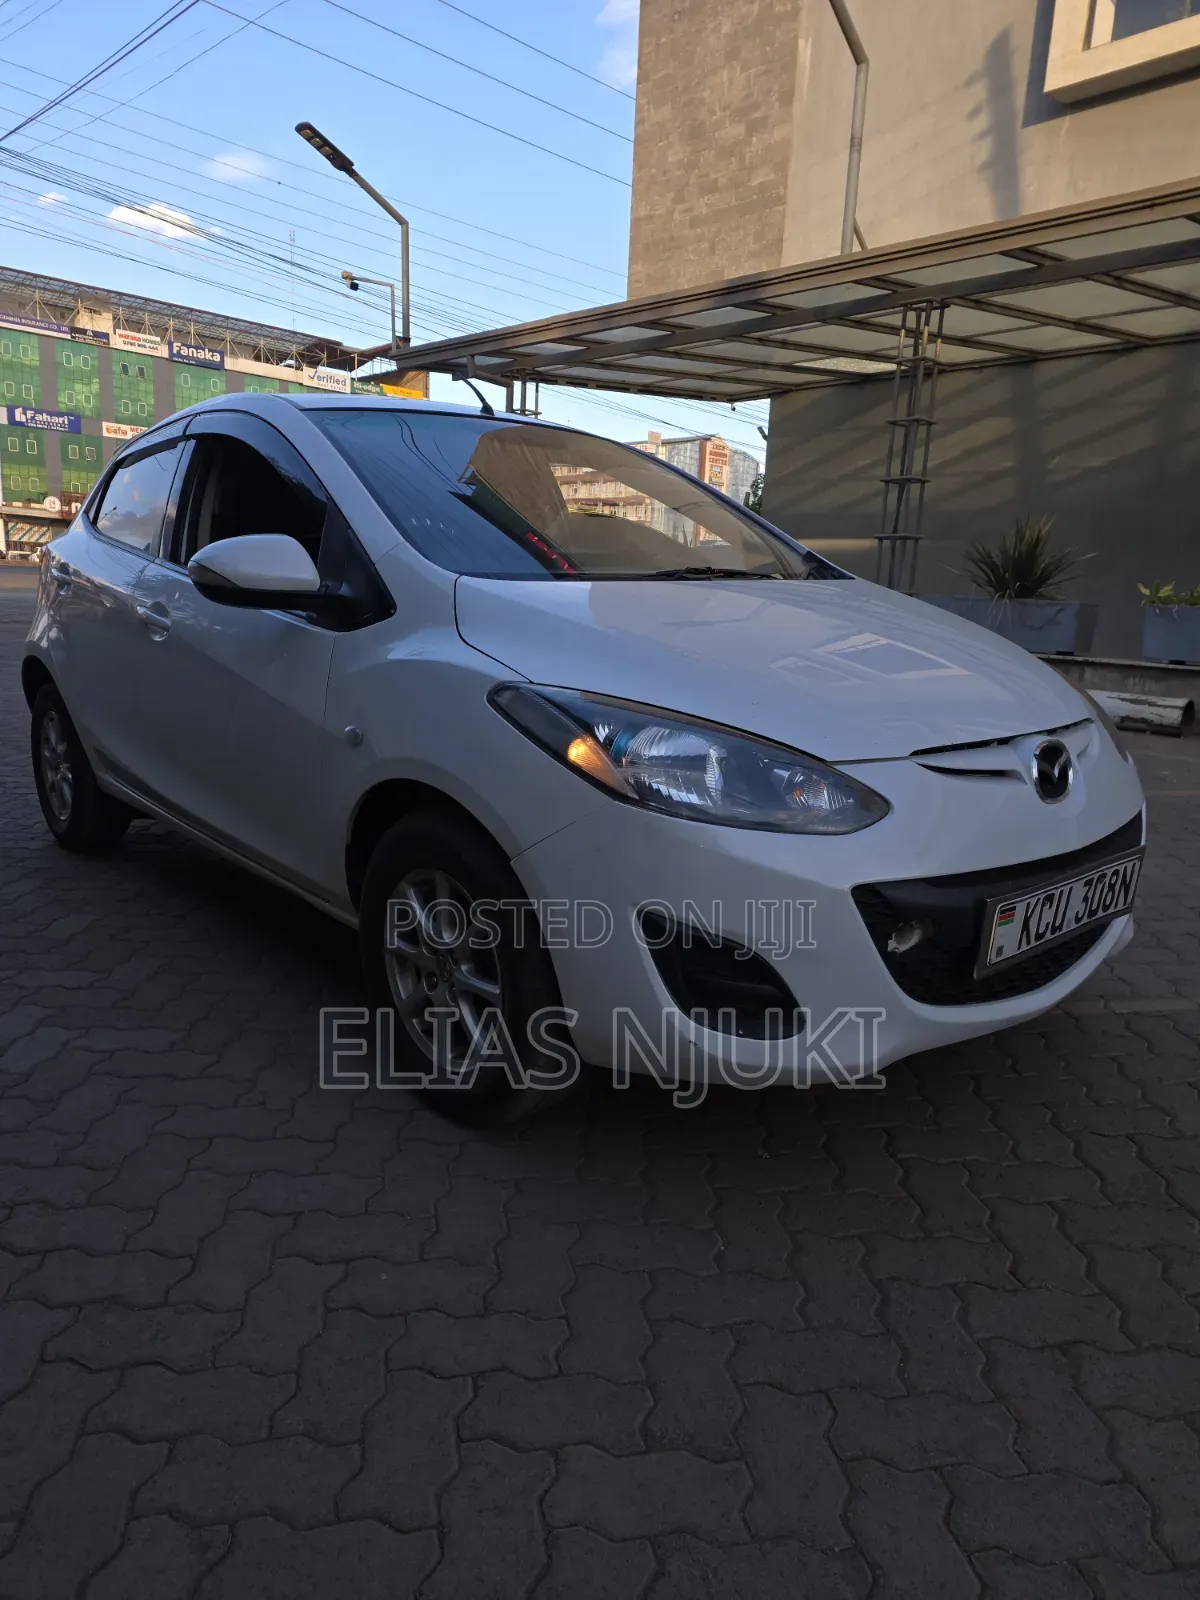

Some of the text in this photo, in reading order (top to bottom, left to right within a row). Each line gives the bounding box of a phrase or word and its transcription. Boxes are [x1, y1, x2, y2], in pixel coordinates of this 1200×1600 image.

[173, 342, 221, 362] Fanaka
[26, 410, 69, 424] Fahari
[1017, 861, 1137, 951] KCU 308N
